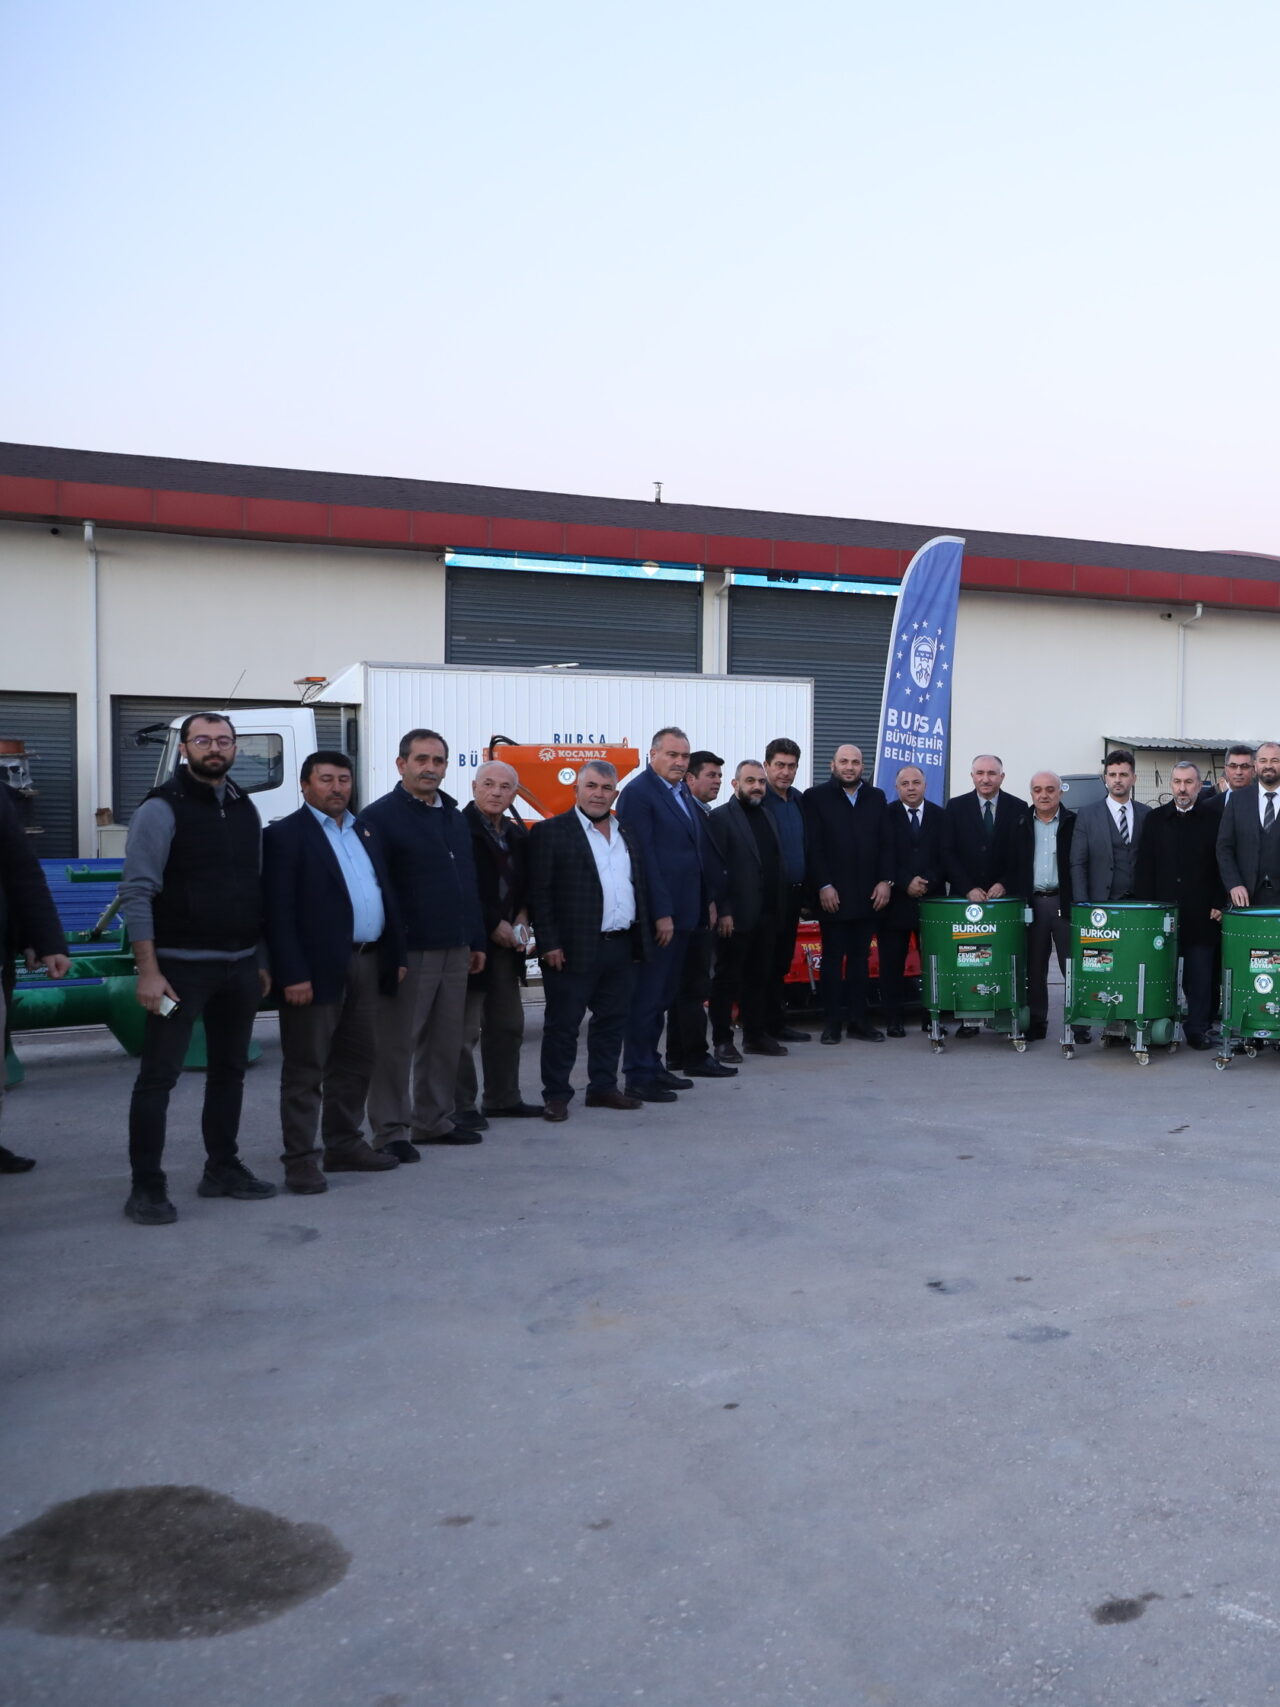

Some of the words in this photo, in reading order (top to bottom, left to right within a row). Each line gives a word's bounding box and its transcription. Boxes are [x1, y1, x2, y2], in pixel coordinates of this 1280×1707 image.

[887, 708, 944, 736] BURSA
[952, 924, 997, 933] BURKON
[1080, 927, 1120, 939] BURKON
